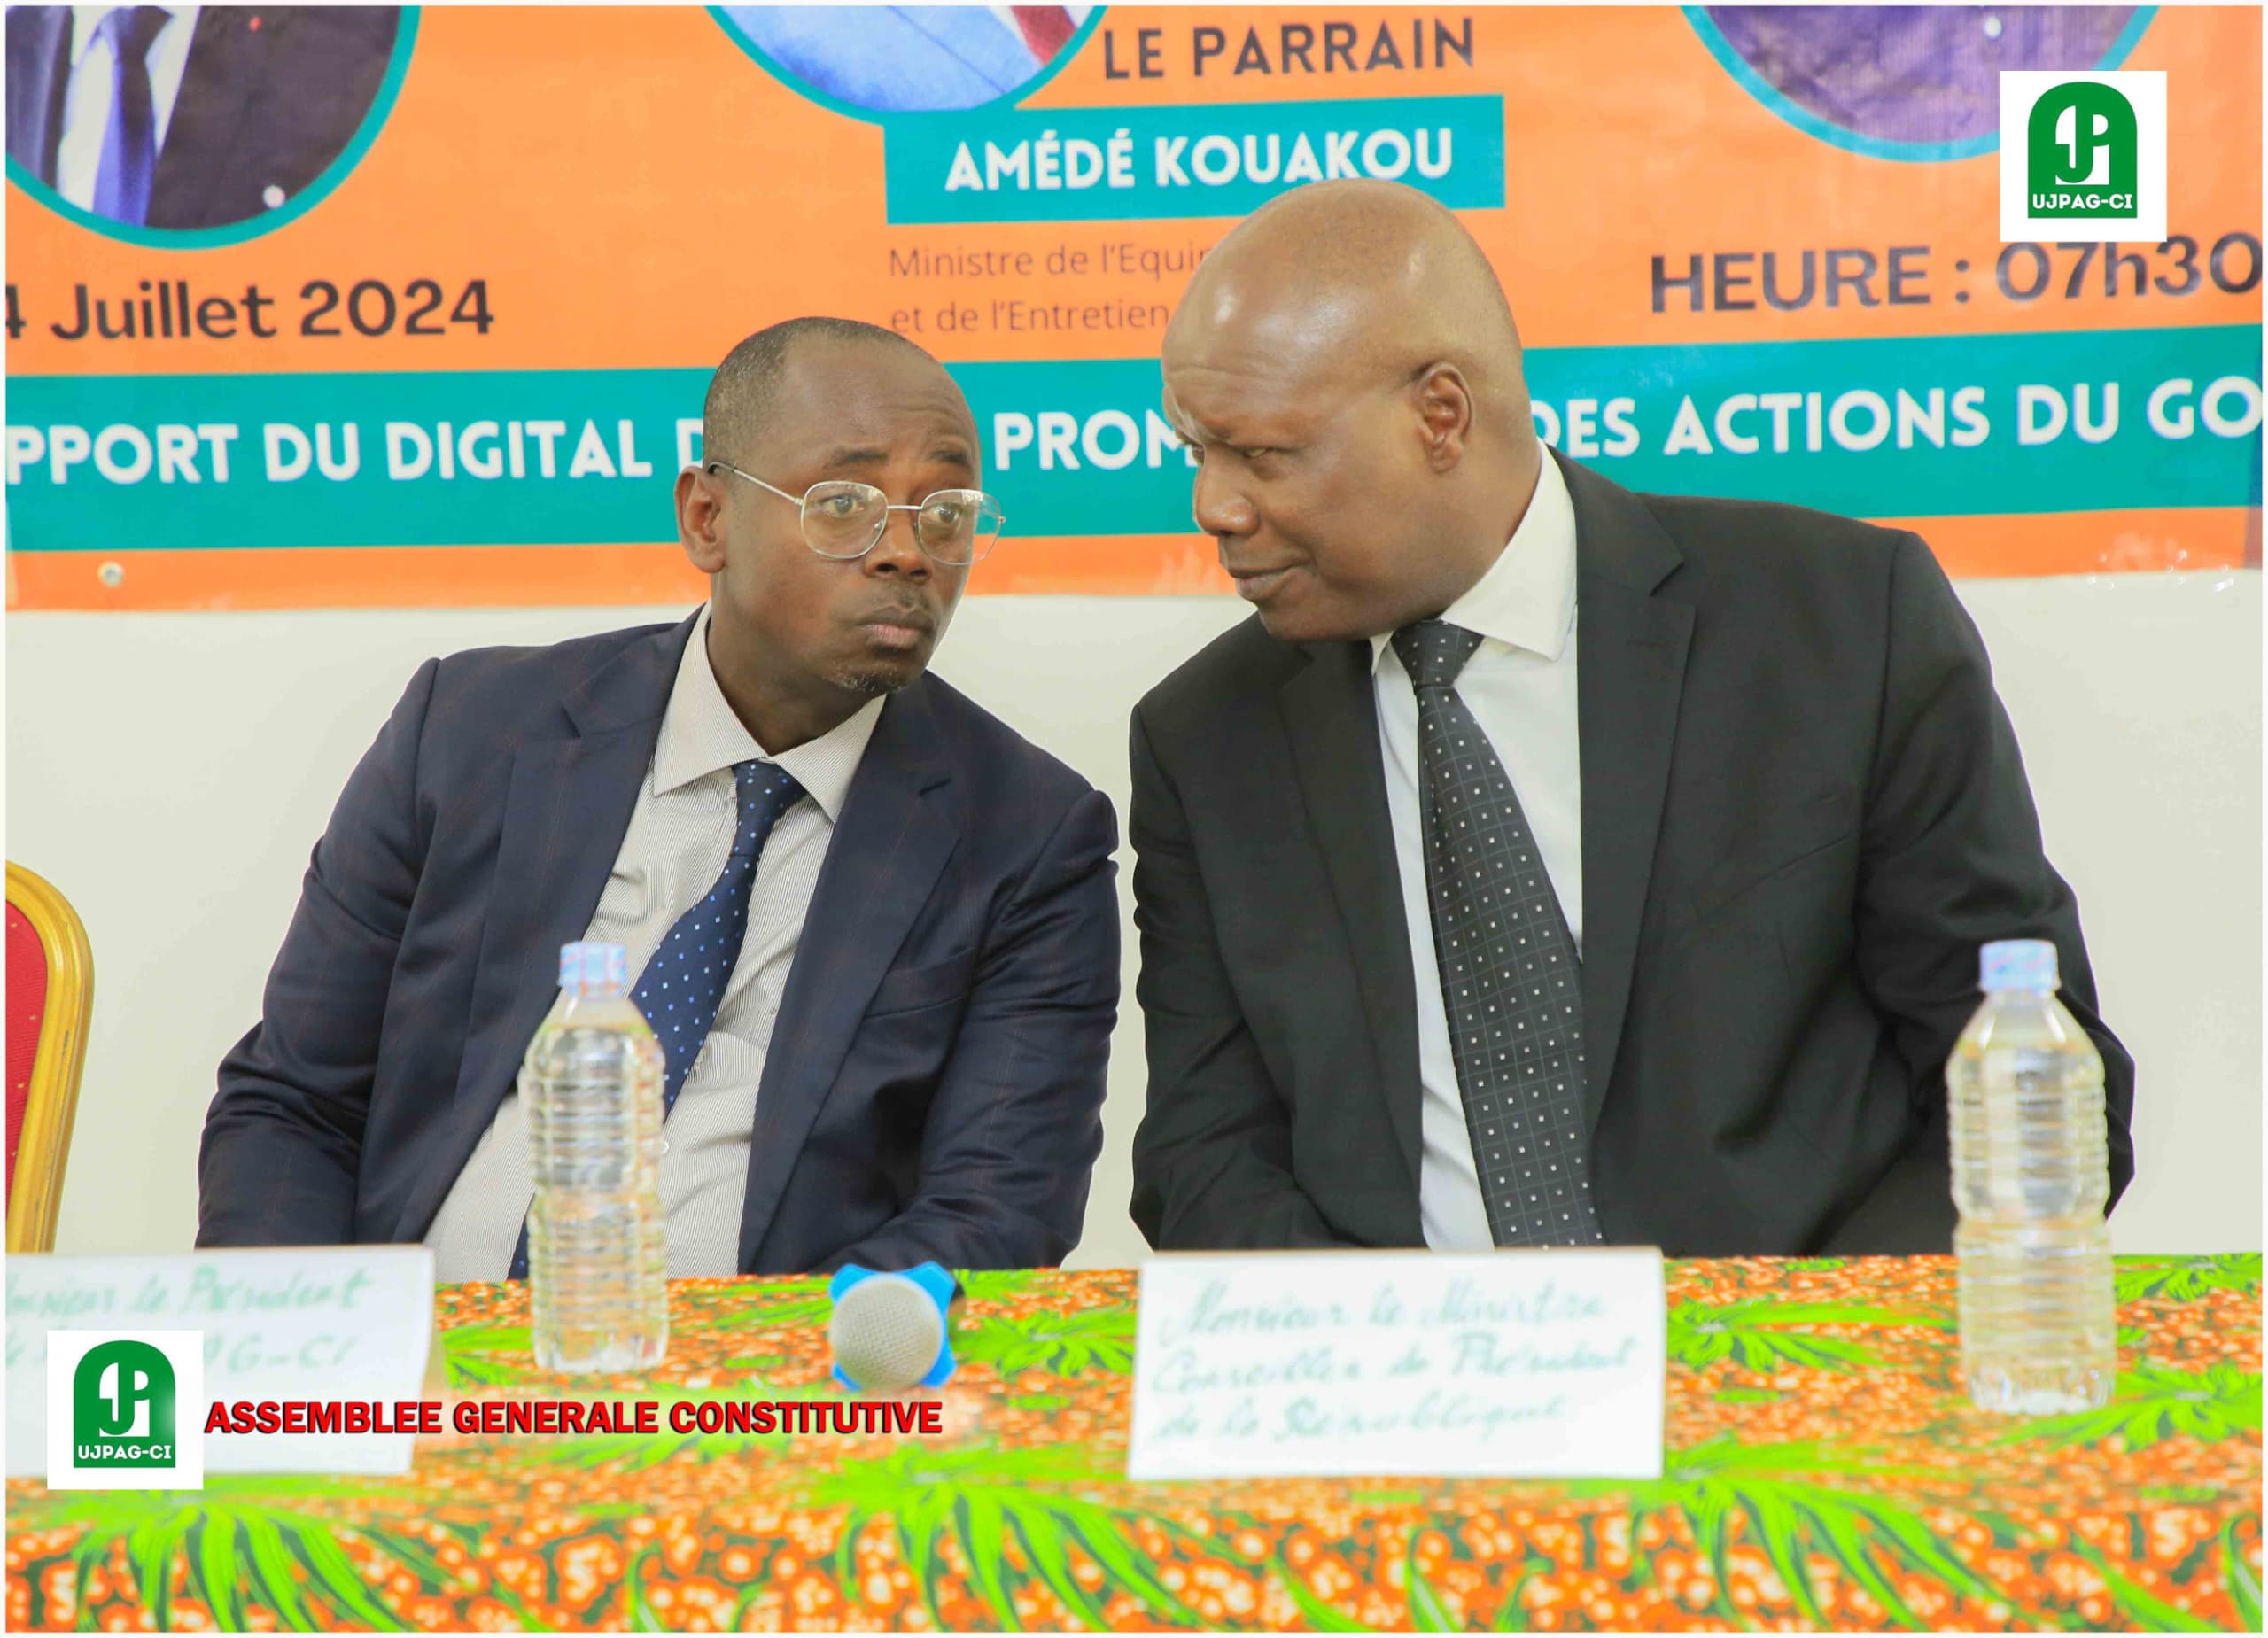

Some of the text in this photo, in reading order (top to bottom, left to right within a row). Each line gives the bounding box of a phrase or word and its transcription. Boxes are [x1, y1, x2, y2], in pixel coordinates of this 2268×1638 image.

[1103, 17, 1474, 80] LE PARRAIN
[944, 128, 1453, 192] AMÉDÉ KOUAKOU
[889, 247, 1034, 277] Ministre
[1045, 243, 1090, 276] de
[1651, 245, 1932, 314] HEURE
[1995, 231, 2263, 302] 07h30
[50, 279, 278, 341] Juillet
[299, 277, 495, 338] 2024
[890, 298, 1169, 335] et de l'Entretien
[6, 423, 240, 485] PPORT
[263, 422, 361, 482] DU
[384, 418, 653, 481] DIGITAL
[1662, 385, 1991, 457] ACTIONS
[2016, 381, 2120, 446] DU
[2146, 375, 2263, 440] GO
